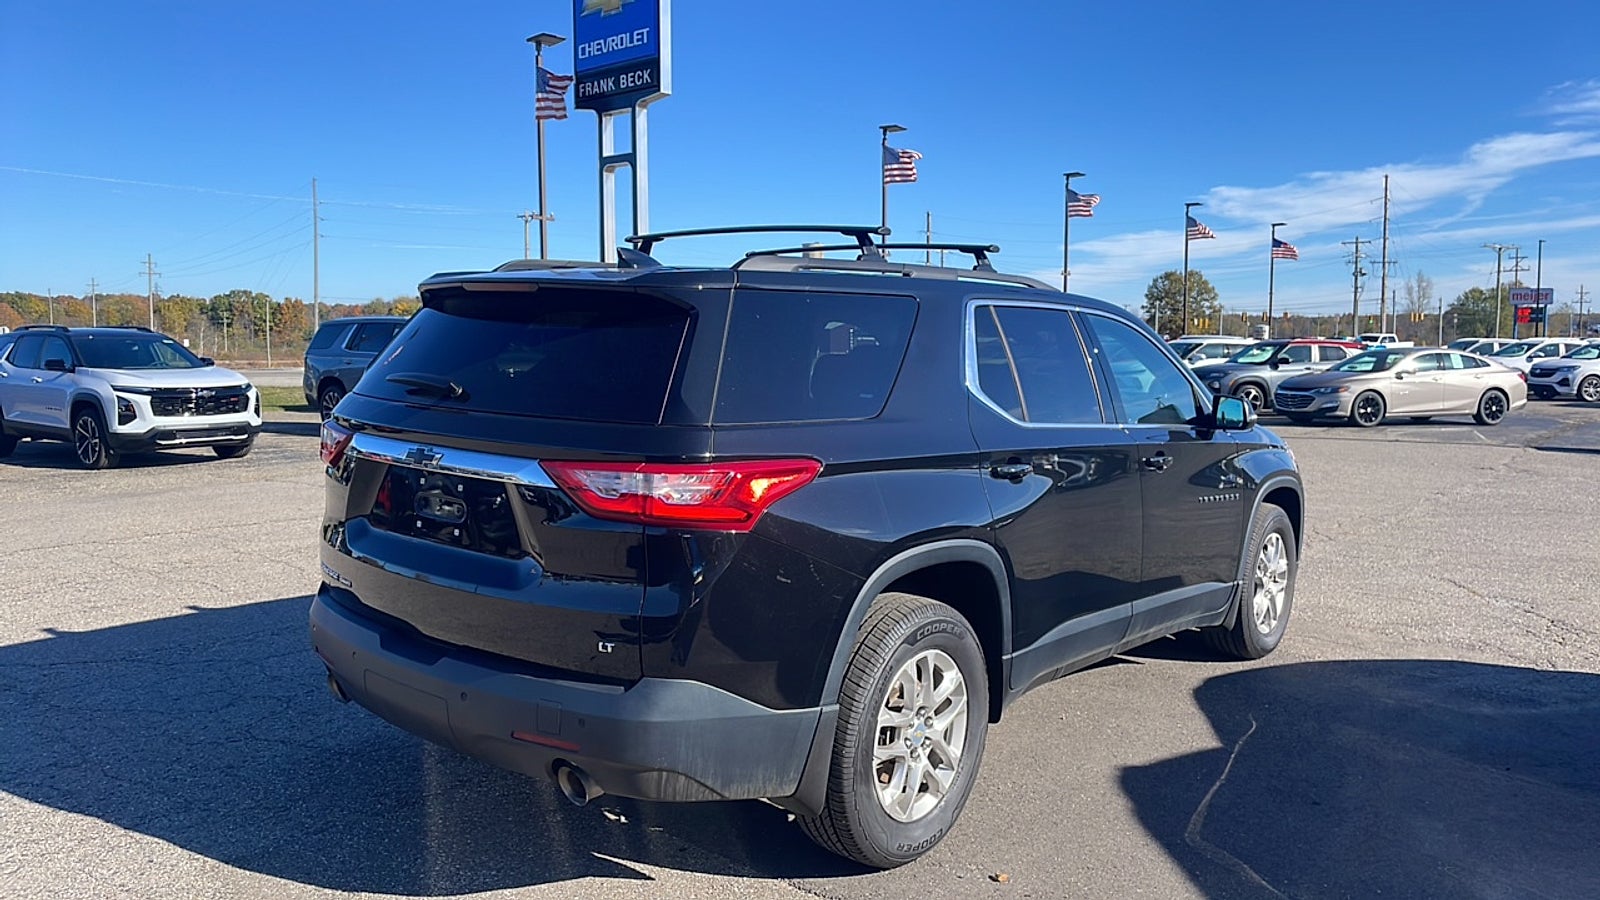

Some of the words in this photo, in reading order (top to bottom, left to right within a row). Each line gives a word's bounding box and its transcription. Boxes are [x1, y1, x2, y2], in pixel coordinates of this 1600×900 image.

[578, 27, 650, 59] CHEVROLET
[579, 77, 616, 98] FRANK
[620, 69, 651, 89] BECK
[1512, 290, 1549, 304] meijer
[917, 623, 962, 640] COOPER
[598, 641, 615, 653] LT
[897, 828, 943, 853] COOPER
